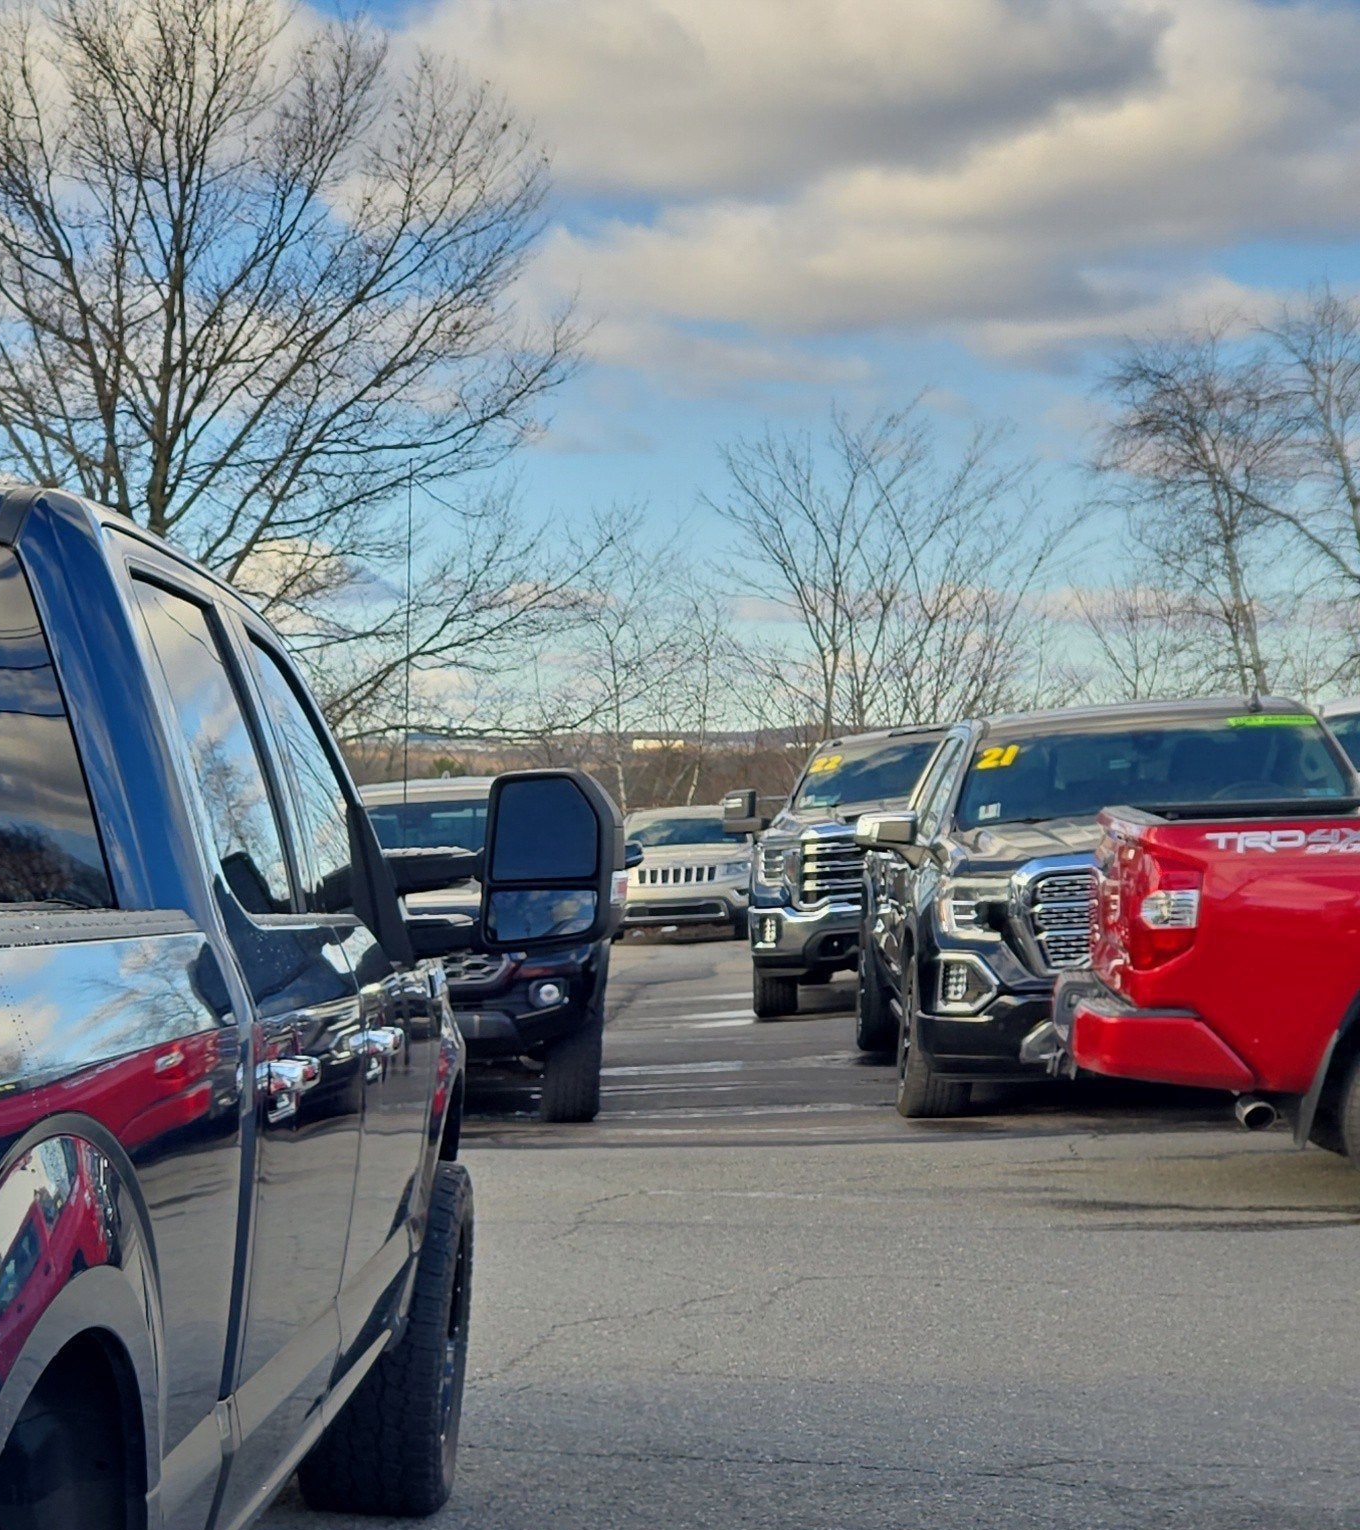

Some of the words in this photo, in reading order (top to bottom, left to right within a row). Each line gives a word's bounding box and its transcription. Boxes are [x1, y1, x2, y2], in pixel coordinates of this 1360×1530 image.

[809, 755, 843, 774] 22
[977, 745, 1020, 769] 21
[1205, 829, 1306, 854] TRD
